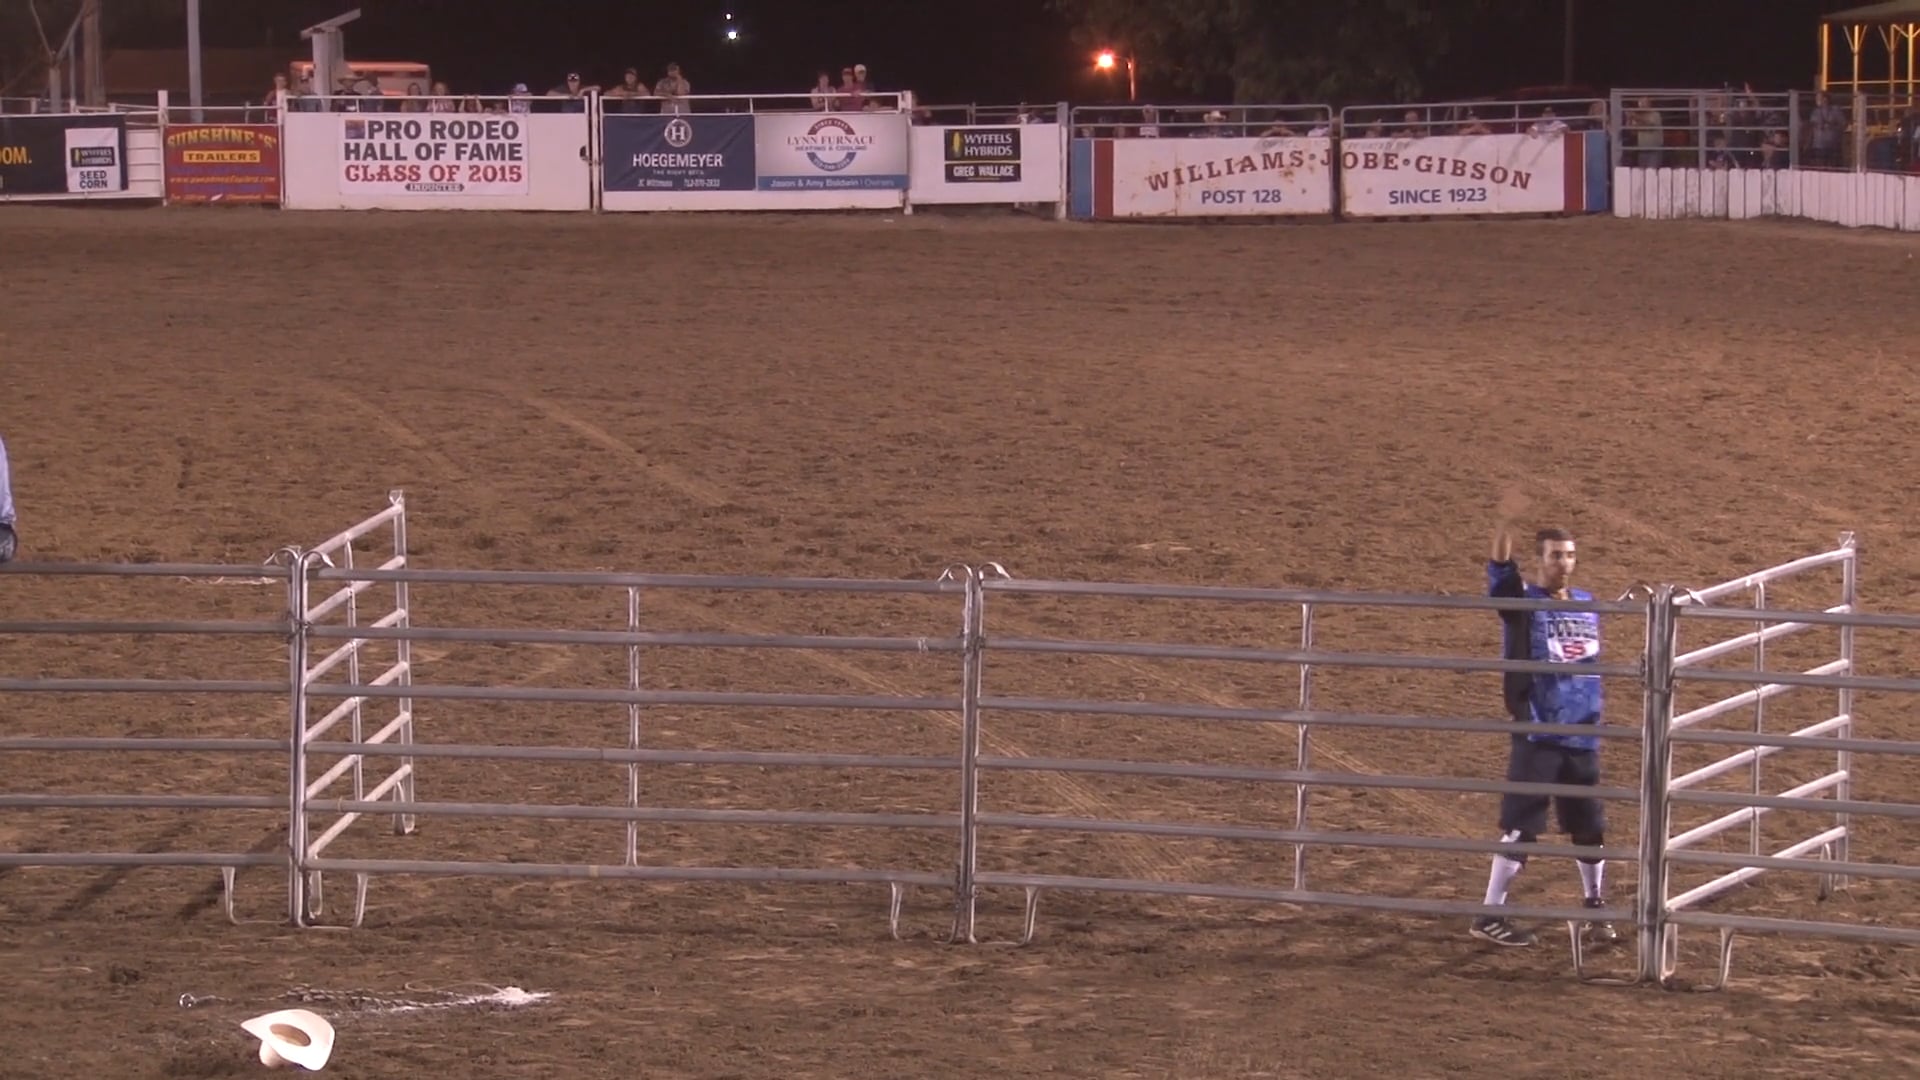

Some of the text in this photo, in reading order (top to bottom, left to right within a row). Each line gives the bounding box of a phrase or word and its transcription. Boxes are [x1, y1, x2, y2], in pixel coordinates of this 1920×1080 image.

[367, 120, 519, 140] PRO RODEO
[167, 127, 255, 147] SUNSHINE
[787, 135, 876, 145] LYNN FURNACE
[964, 133, 1013, 144] WYFFELS
[344, 142, 523, 161] HALL OF FAME
[964, 145, 1013, 156] HYBRIDS
[187, 153, 257, 161] TRAILERS
[632, 153, 723, 168] HOEGEMEYER
[80, 170, 107, 179] SEED
[345, 164, 522, 182] CLASS OF 2015
[953, 165, 1014, 177] GREG WALLACE
[80, 179, 108, 189] CORN
[410, 184, 460, 192] INDUCTEE
[1201, 189, 1282, 204] POST 128
[1389, 187, 1487, 205] SINCE 1923
